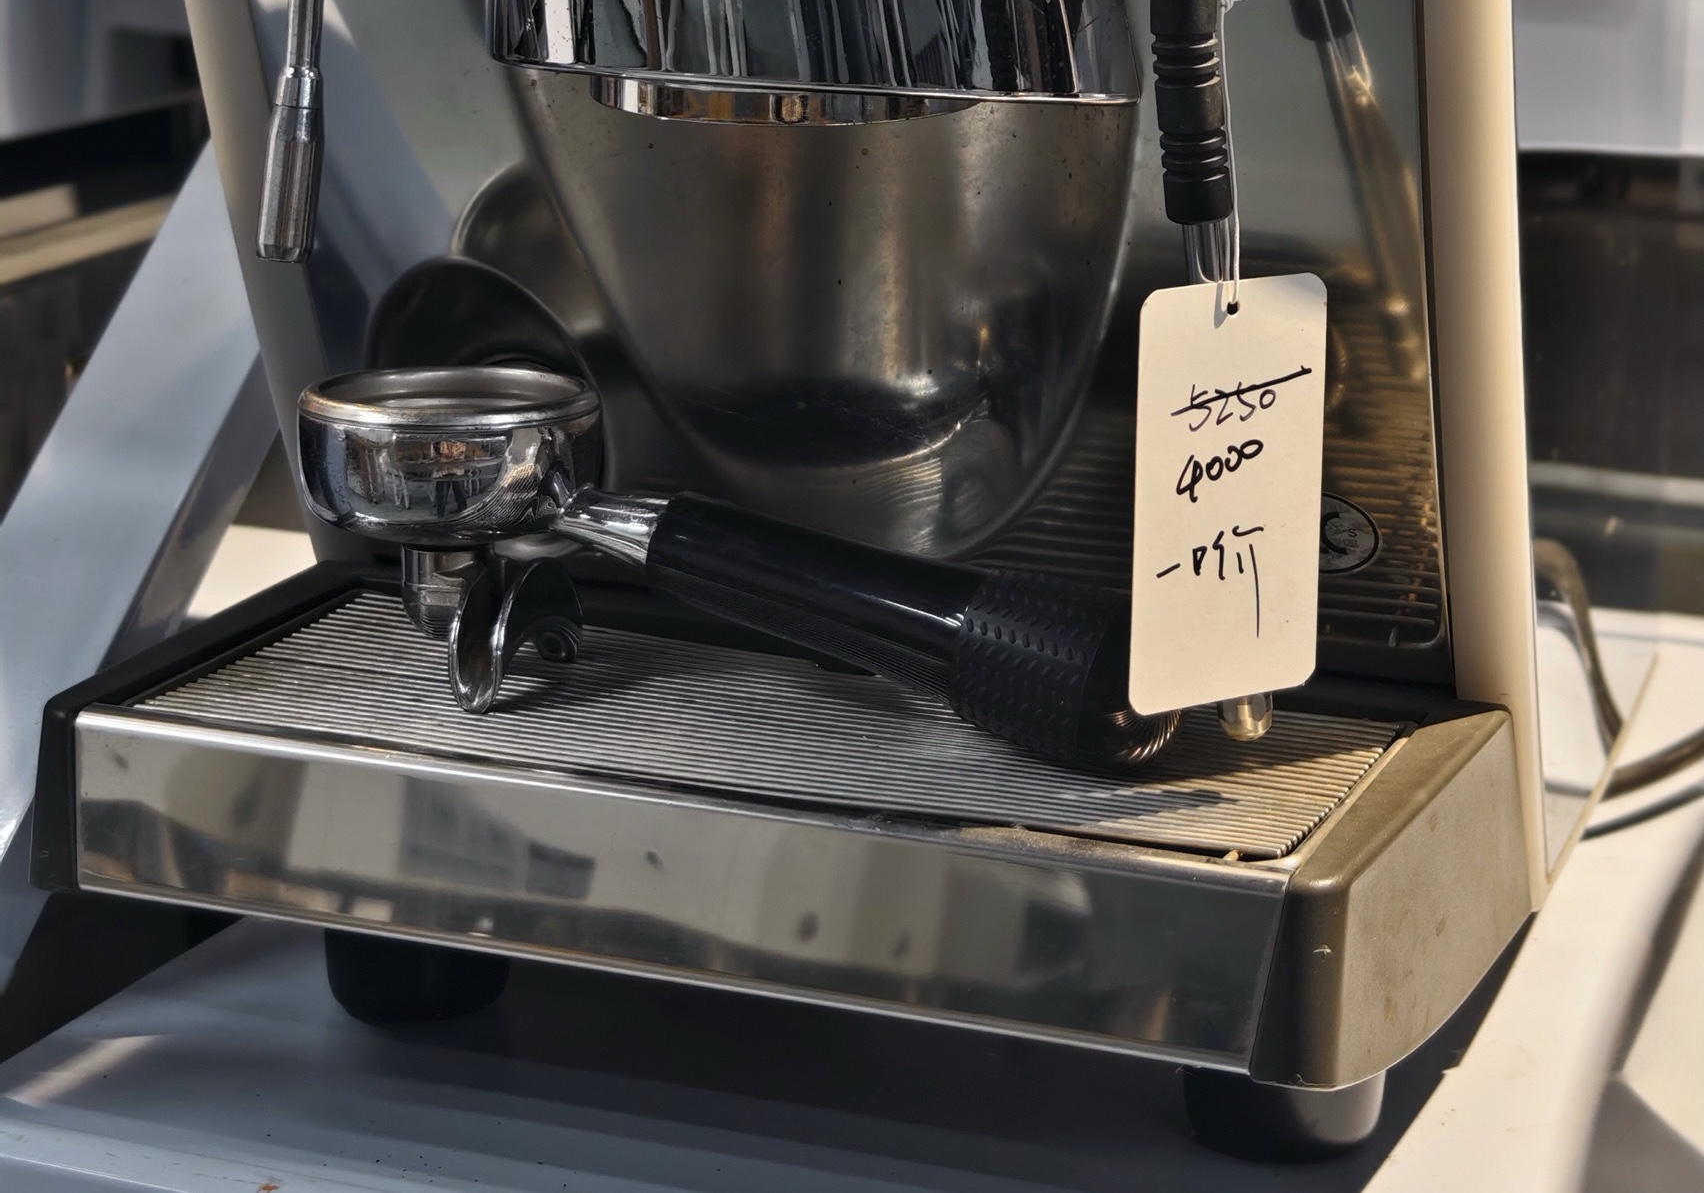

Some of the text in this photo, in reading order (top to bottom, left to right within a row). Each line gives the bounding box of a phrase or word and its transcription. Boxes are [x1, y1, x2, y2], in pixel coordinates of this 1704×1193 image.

[1187, 382, 1277, 432] 5250
[1175, 438, 1265, 503] 4000
[1155, 524, 1265, 640] 一口价
